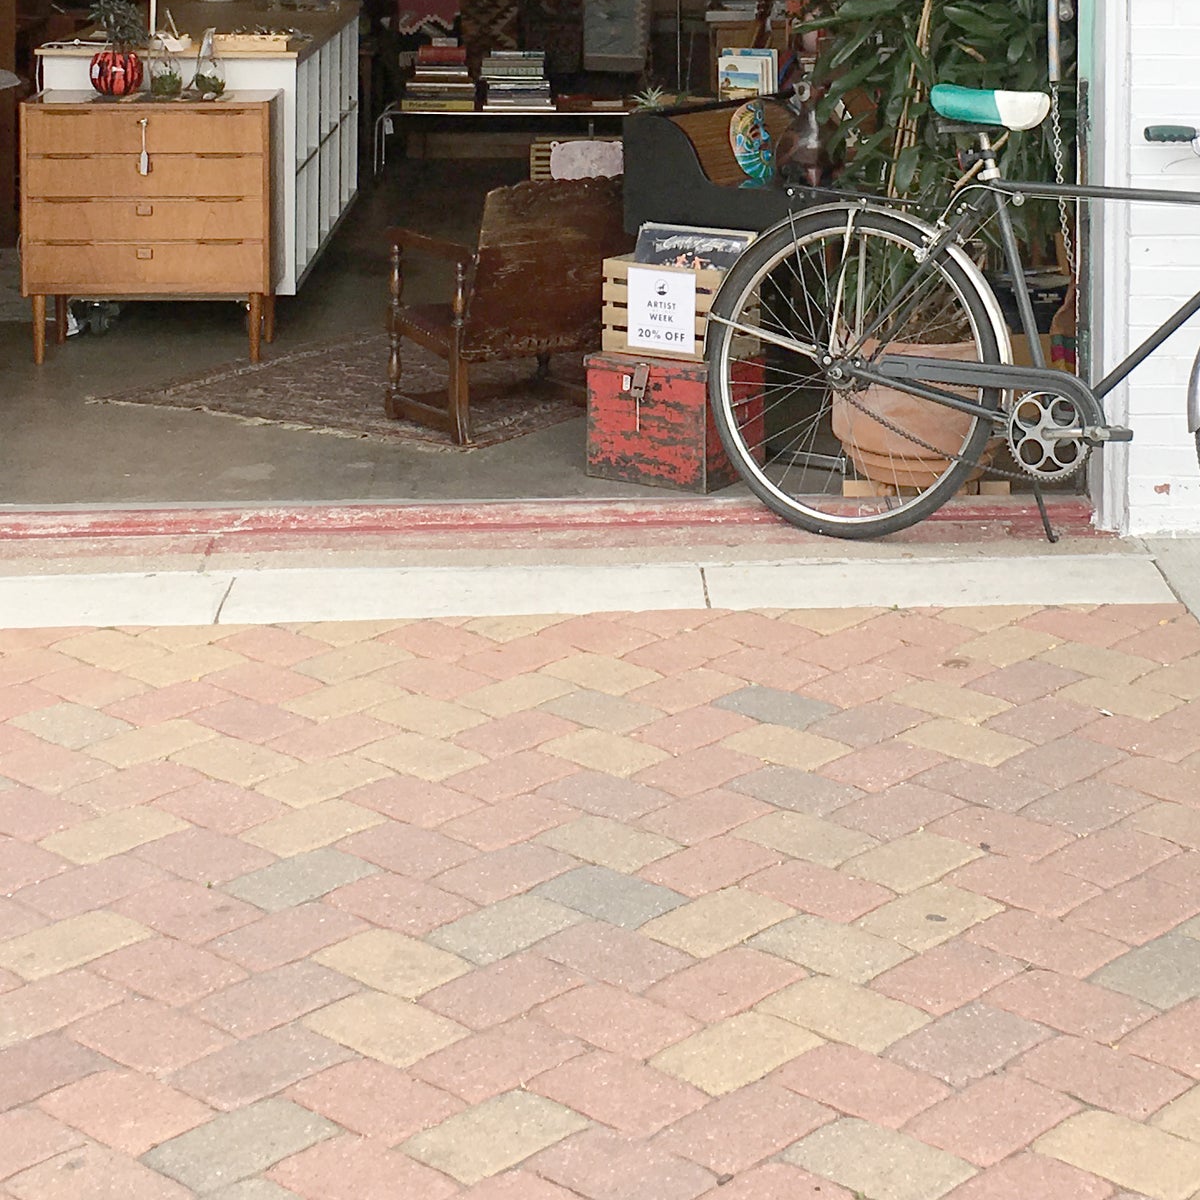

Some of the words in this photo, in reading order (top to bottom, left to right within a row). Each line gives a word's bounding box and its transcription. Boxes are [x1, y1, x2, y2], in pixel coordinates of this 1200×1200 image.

[647, 300, 677, 310] ARTIST
[649, 313, 674, 323] WEEK
[637, 328, 661, 340] 20%
[665, 331, 685, 342] OFF
